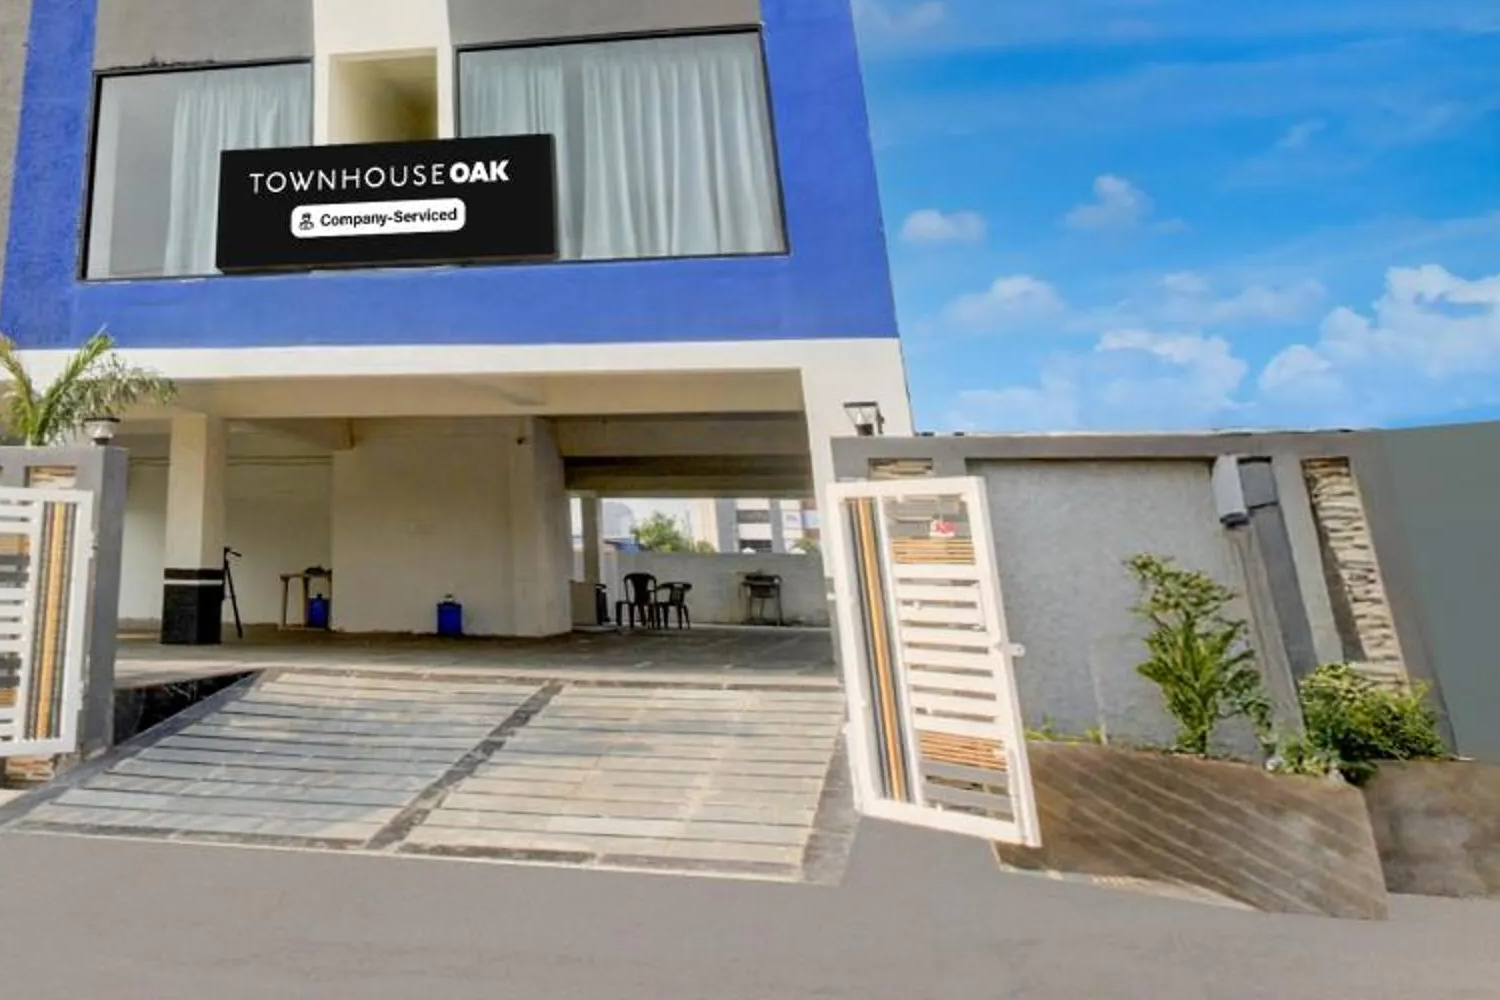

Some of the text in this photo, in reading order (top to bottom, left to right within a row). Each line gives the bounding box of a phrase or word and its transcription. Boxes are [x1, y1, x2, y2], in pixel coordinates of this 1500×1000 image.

[249, 160, 510, 194] TOWNHOUSE OAK
[319, 208, 457, 228] Company-Serviced
